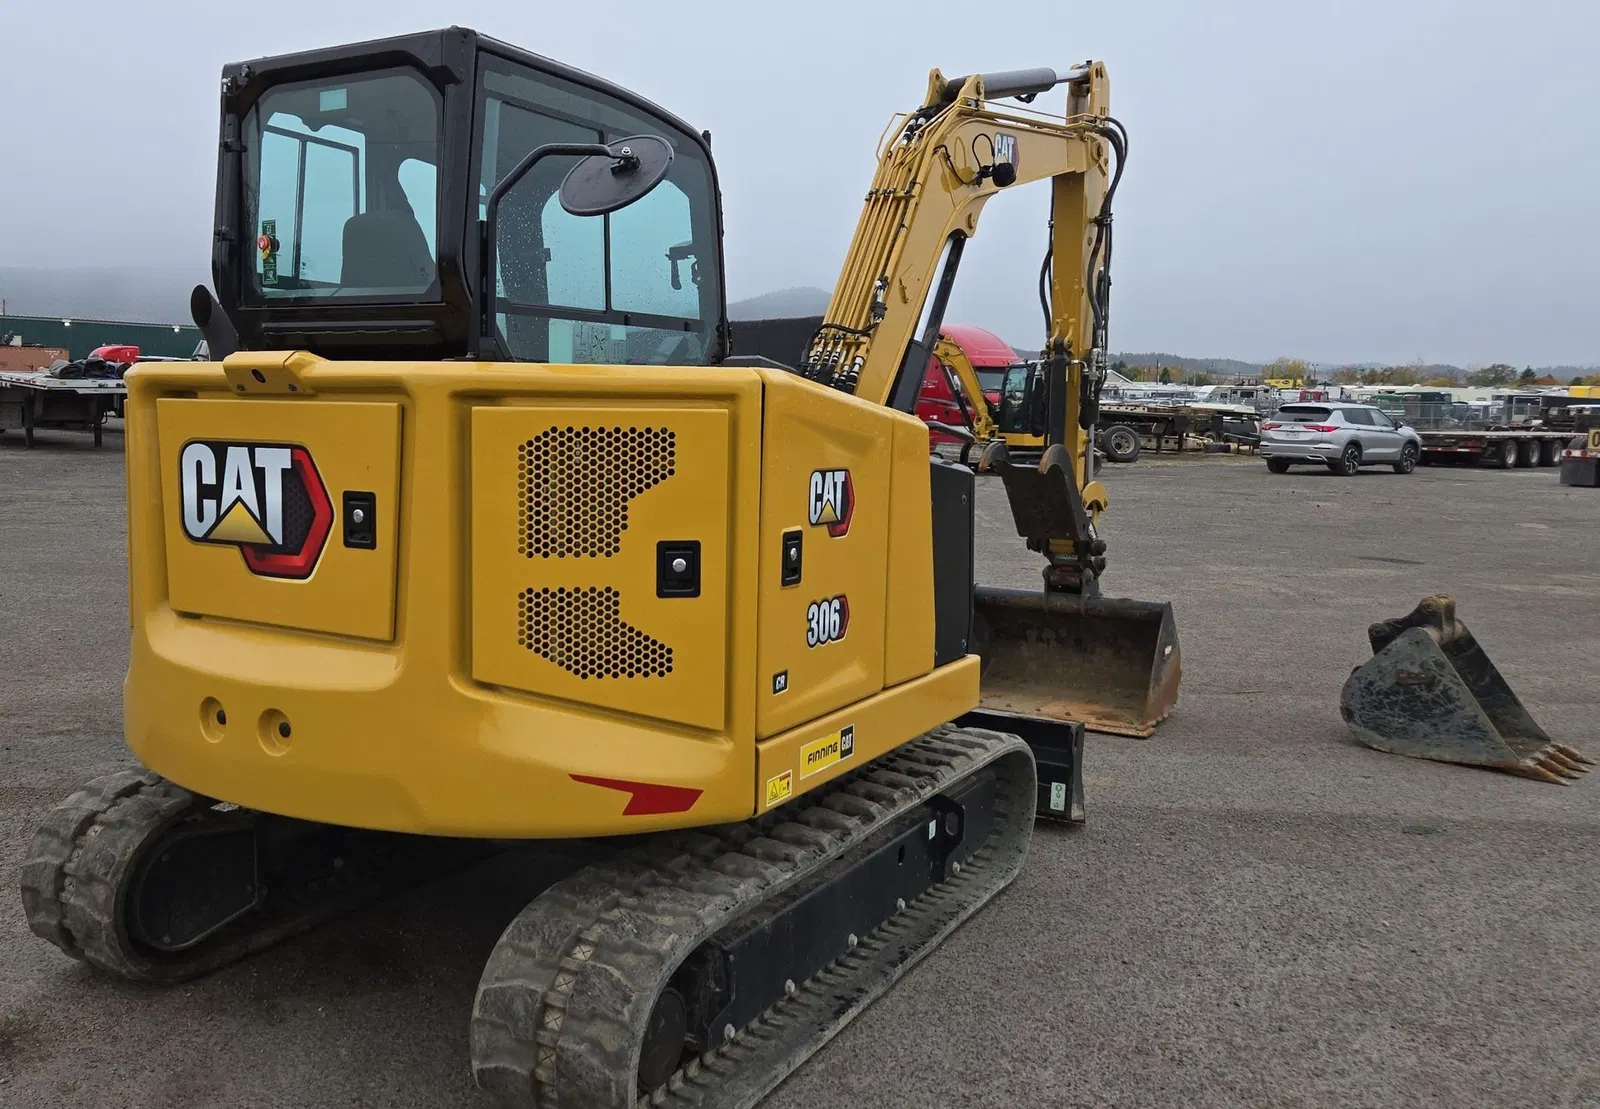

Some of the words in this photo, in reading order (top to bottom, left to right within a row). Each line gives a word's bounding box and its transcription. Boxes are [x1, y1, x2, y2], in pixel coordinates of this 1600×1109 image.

[995, 134, 1014, 166] CAT
[182, 443, 292, 545] CAT
[811, 471, 845, 524] CAT
[808, 599, 840, 646] 306
[776, 675, 785, 690] CR
[807, 742, 838, 765] FINNING
[841, 733, 852, 750] CAT
